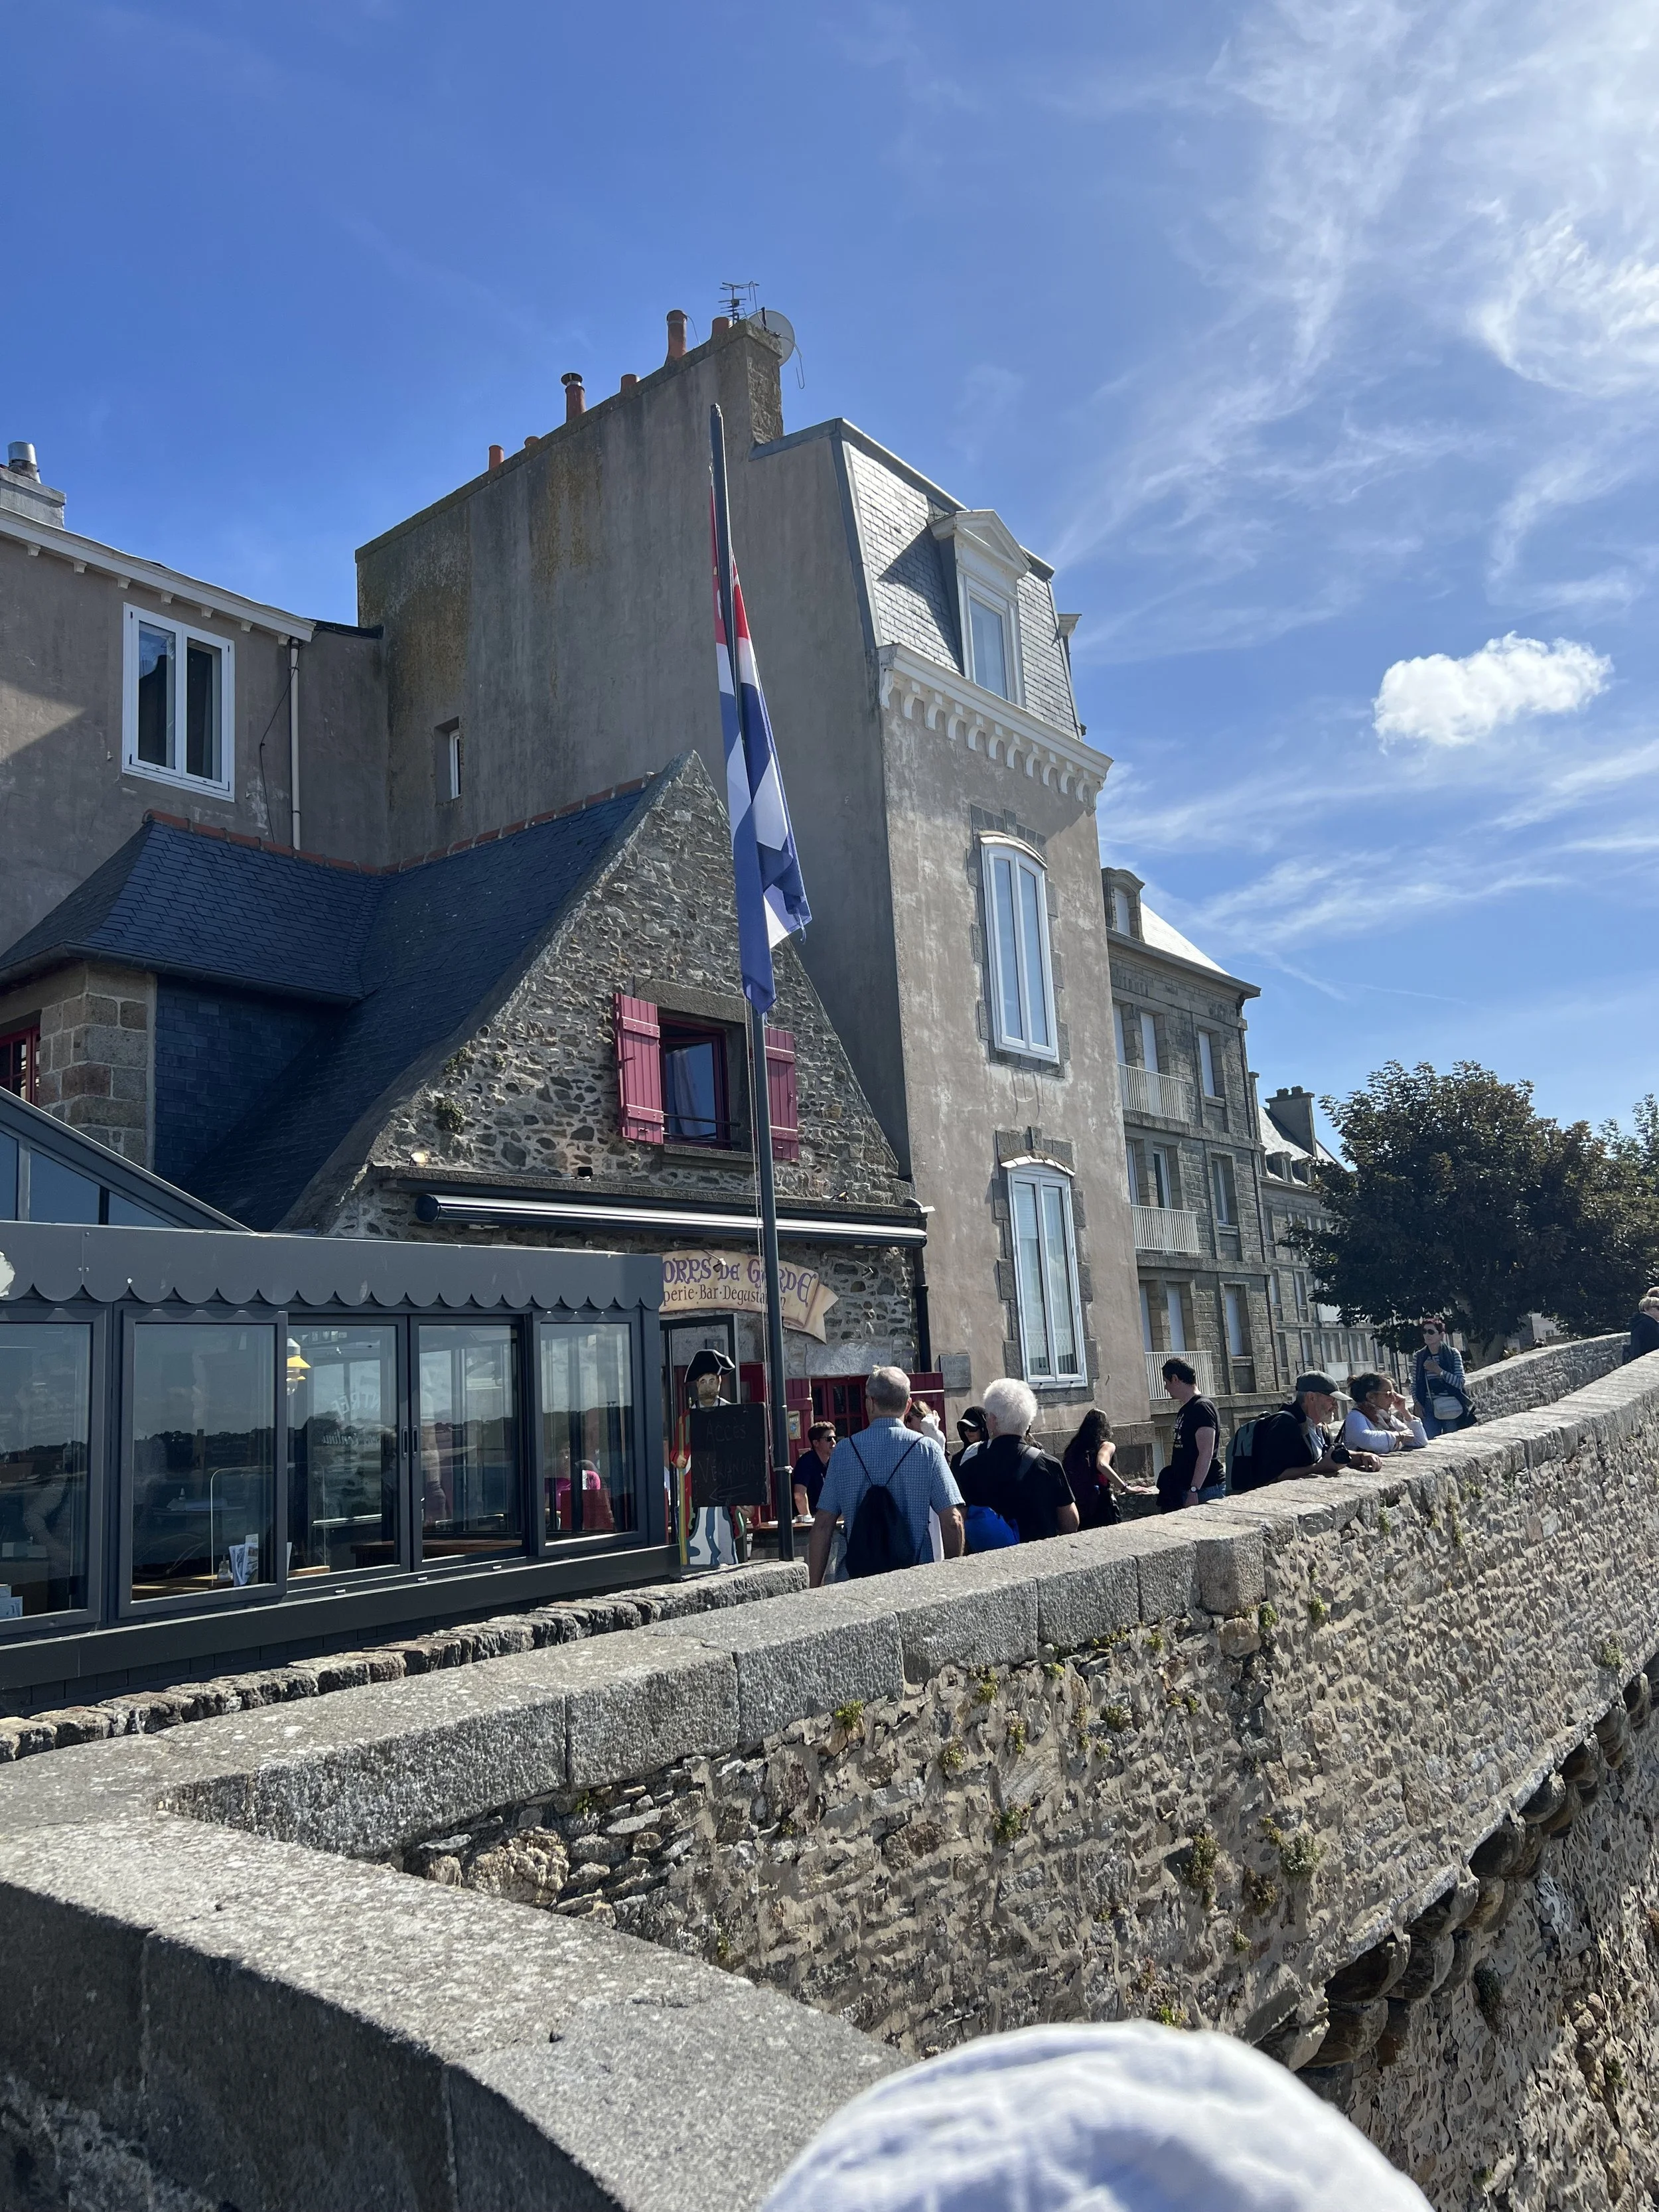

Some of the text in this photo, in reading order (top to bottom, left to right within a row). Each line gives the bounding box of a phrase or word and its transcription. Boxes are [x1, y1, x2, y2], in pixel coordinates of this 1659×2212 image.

[663, 1257, 711, 1284] ORPS
[747, 1258, 817, 1308] GRDE
[663, 1286, 695, 1306] perie
[699, 1284, 718, 1299] Bar
